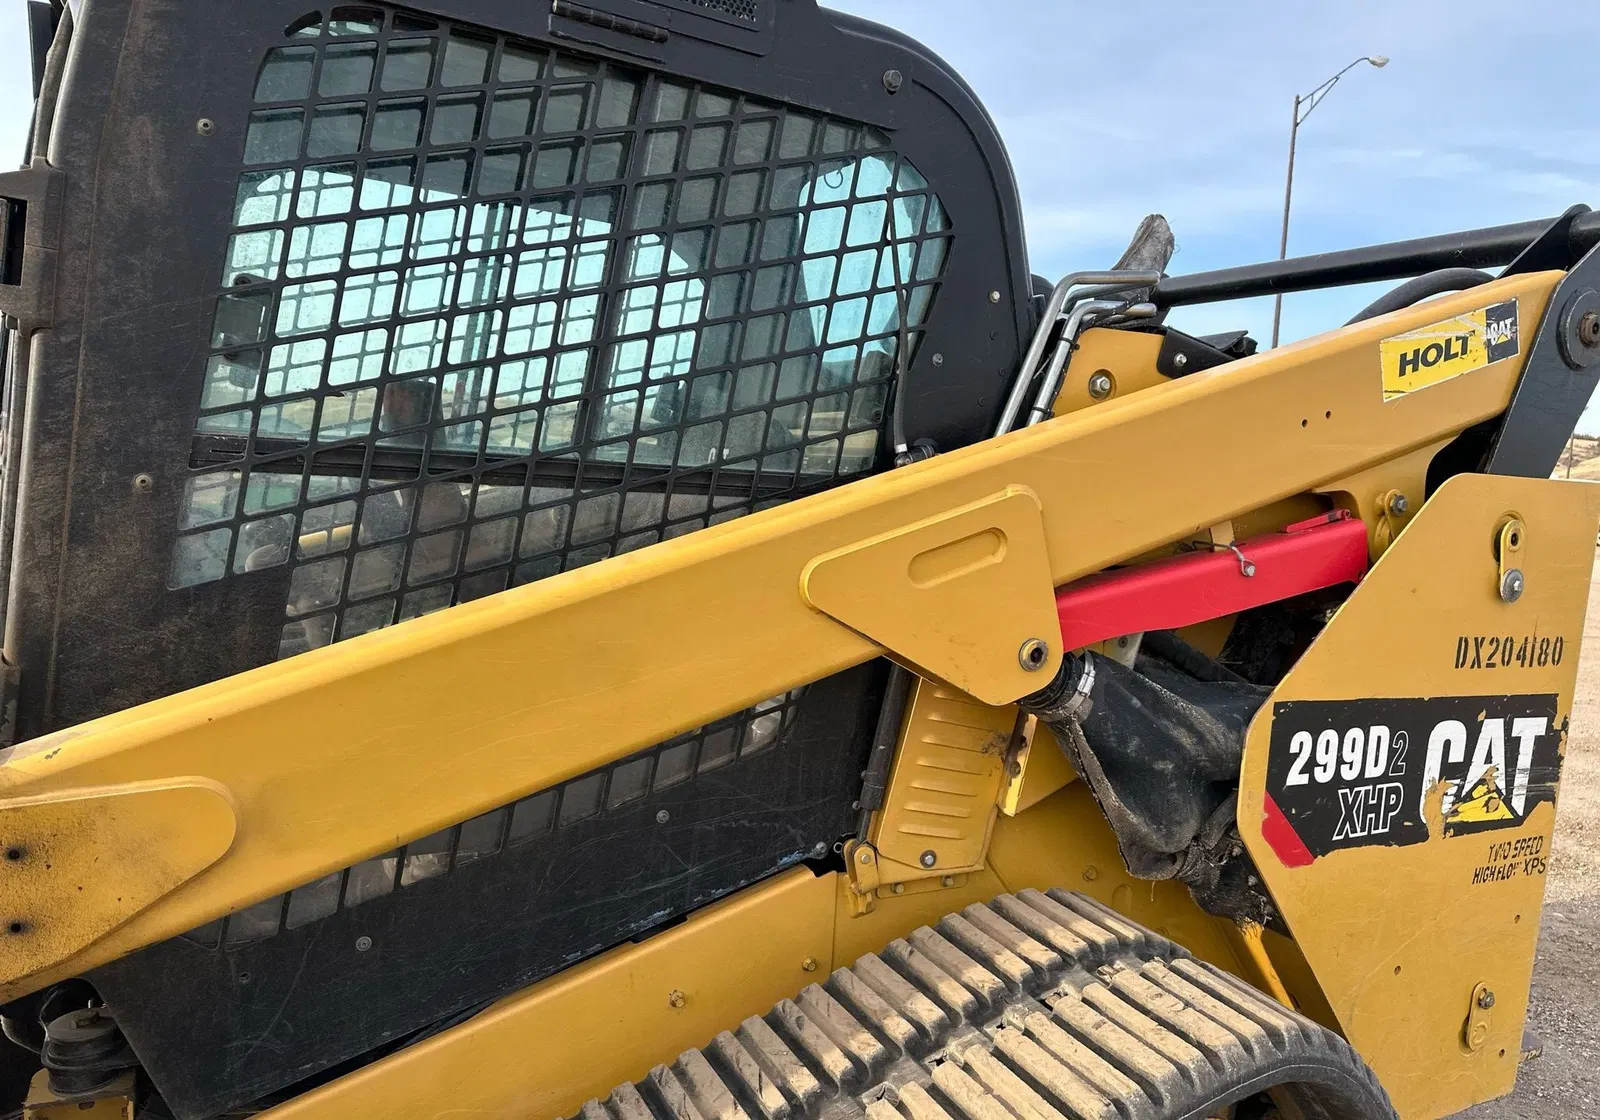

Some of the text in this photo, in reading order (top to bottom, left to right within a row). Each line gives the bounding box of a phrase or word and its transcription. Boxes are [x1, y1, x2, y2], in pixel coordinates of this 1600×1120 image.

[1398, 330, 1475, 377] HOLT
[1454, 635, 1564, 669] DX204180
[1286, 724, 1409, 786] 299D2
[1419, 716, 1548, 824] CAT
[1332, 782, 1404, 841] XHP
[1472, 865, 1497, 884] HIGH
[1523, 857, 1547, 876] XPS
[1512, 836, 1543, 859] SPEED
